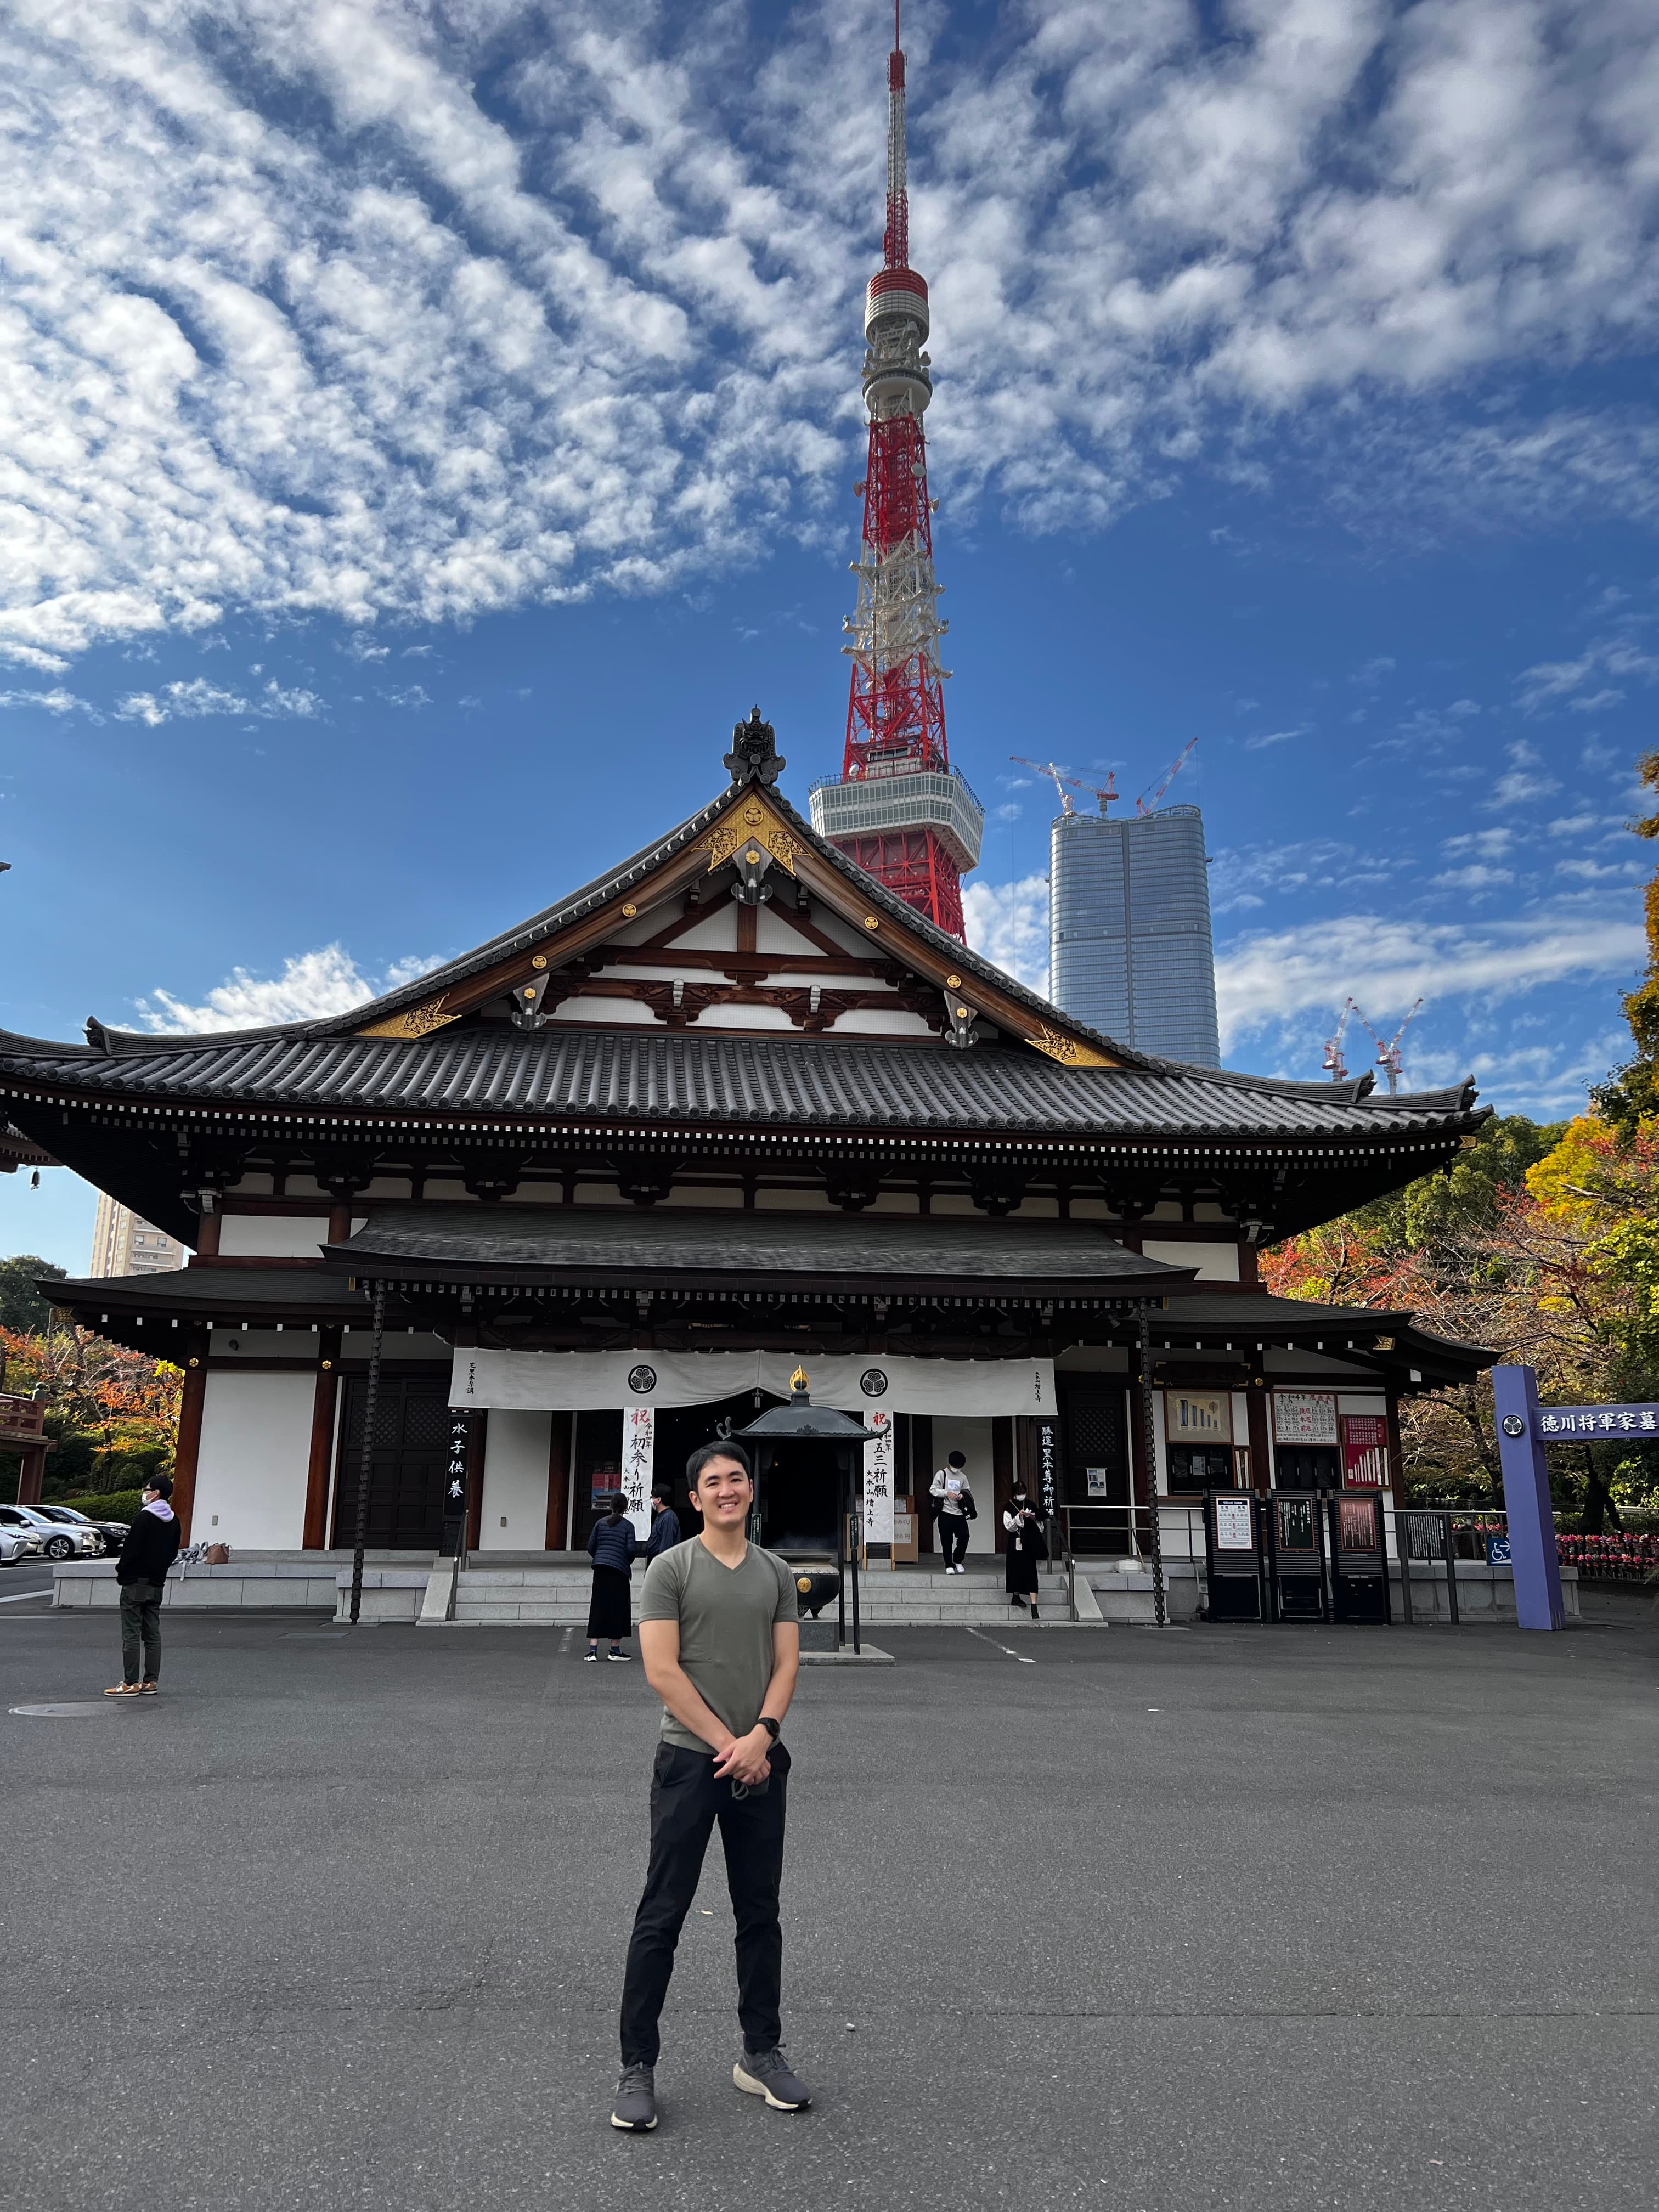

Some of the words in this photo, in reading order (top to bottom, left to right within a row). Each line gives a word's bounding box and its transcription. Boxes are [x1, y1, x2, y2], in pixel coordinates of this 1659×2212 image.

[631, 1409, 650, 1425] 祝
[873, 1412, 887, 1426] 祝
[1541, 1411, 1658, 1433] 徳川将軍家墓
[645, 1423, 653, 1448] 令和四年
[884, 1428, 893, 1451] 和四年
[448, 1423, 468, 1498] 水子供養
[627, 1434, 648, 1512] 初参り祈願
[873, 1436, 888, 1497] 五三祈願
[866, 1470, 875, 1527] 大本山増上寺
